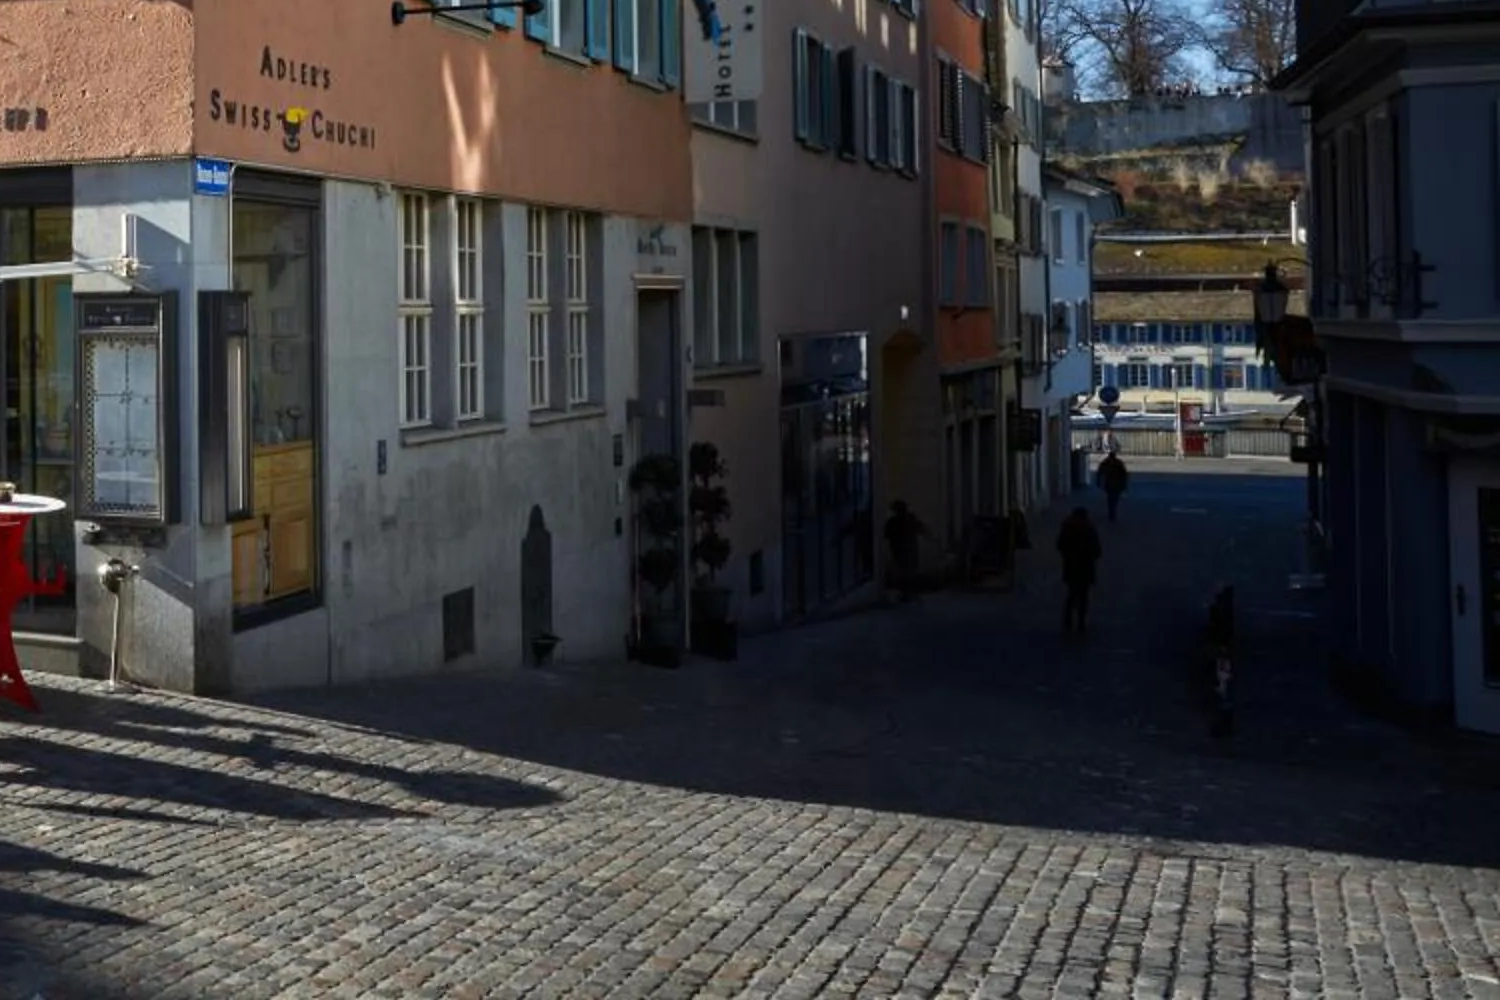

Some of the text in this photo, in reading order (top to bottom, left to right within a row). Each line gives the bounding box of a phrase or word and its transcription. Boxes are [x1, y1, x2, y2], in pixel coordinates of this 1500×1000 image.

[714, 23, 733, 98] HOTEL
[210, 89, 375, 150] SWISS CHUCHI
